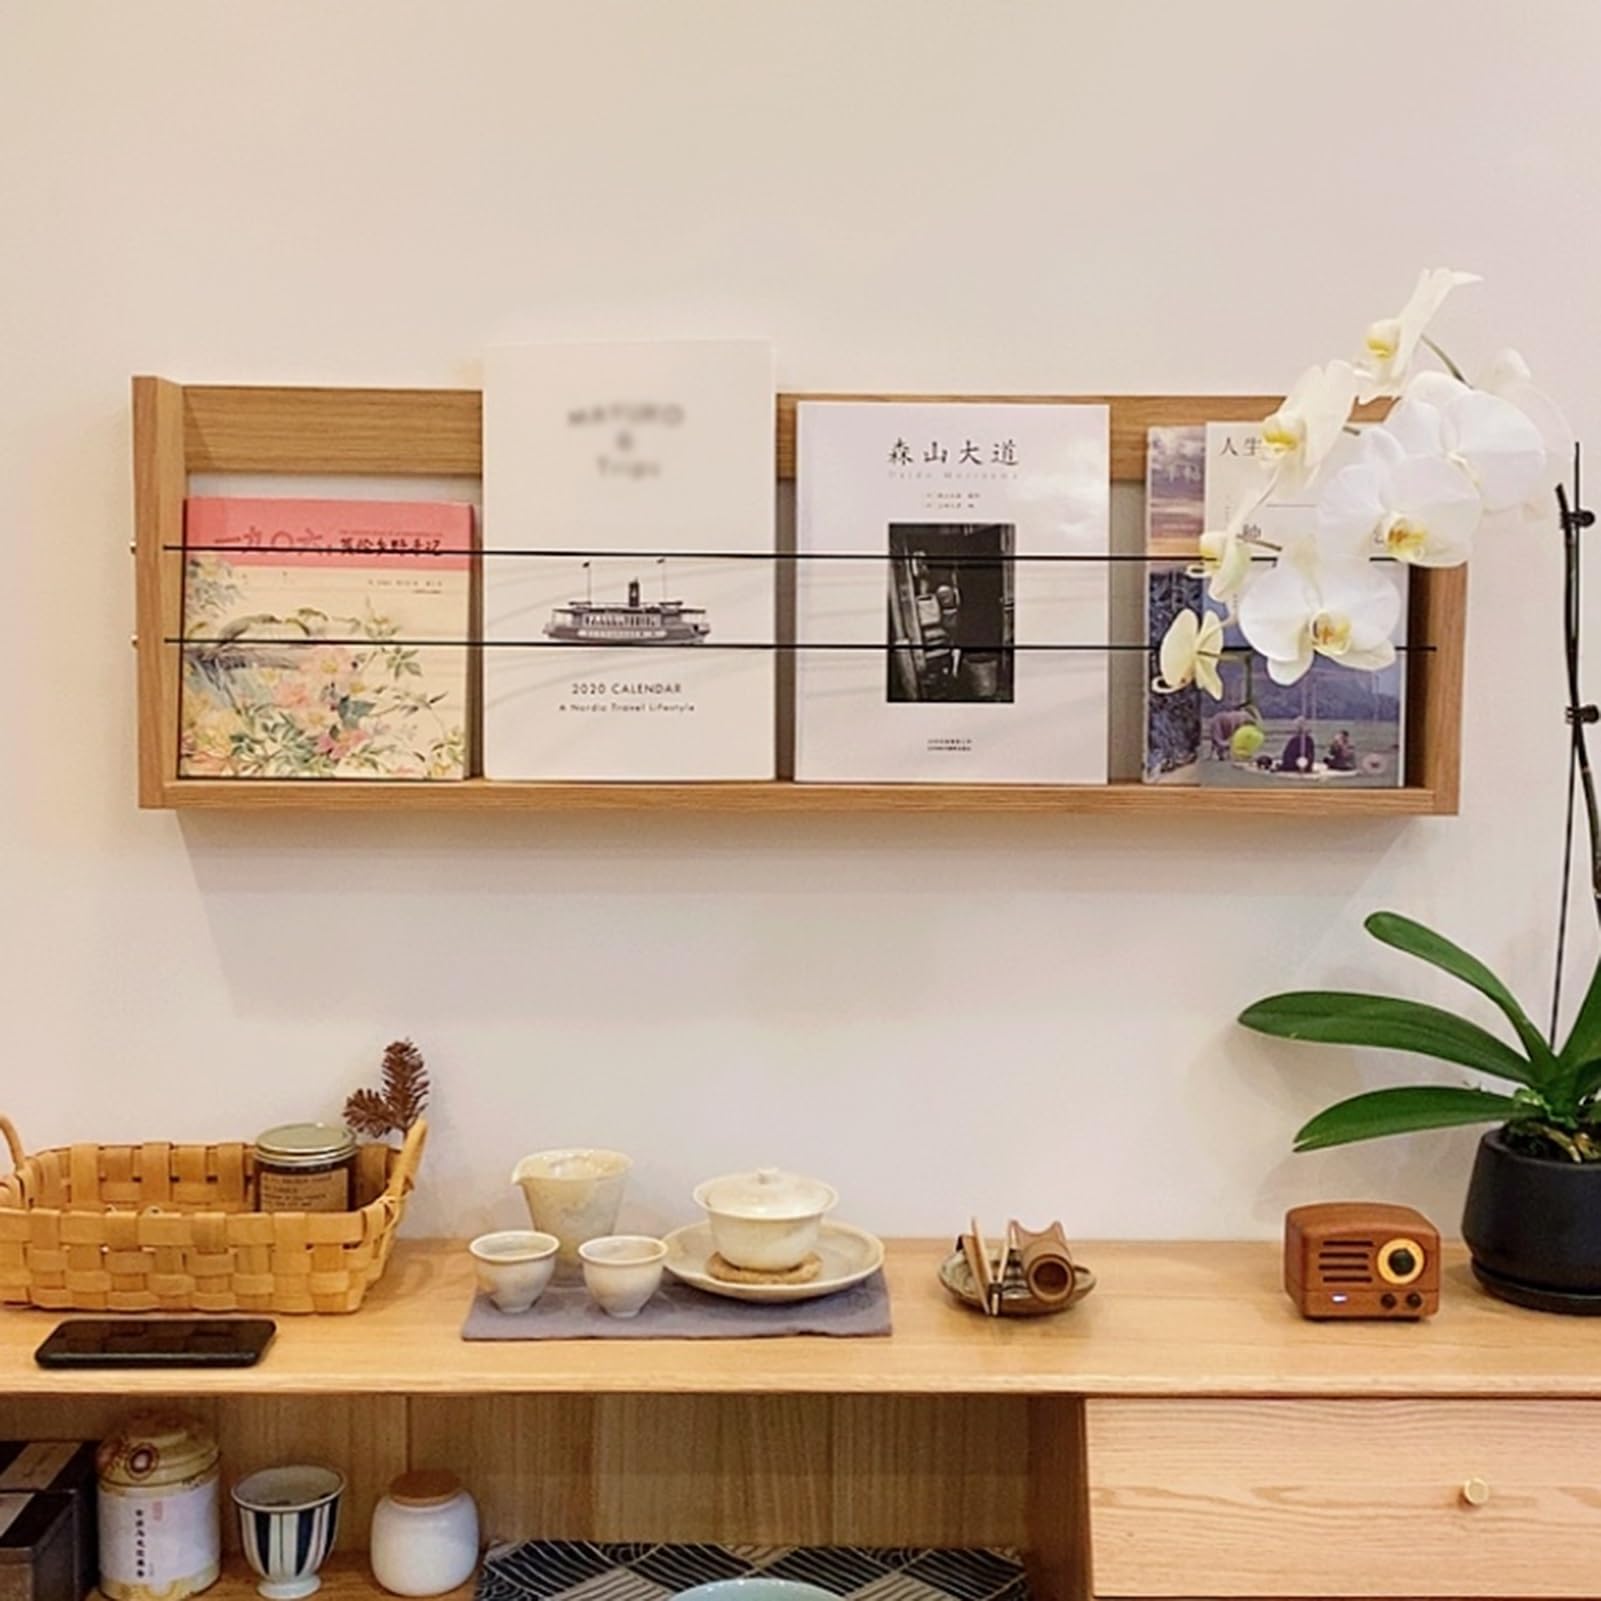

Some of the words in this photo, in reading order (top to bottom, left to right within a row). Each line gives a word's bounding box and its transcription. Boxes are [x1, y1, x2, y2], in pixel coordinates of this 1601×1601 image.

[888, 437, 1020, 466] 森山大道
[571, 682, 607, 695] 2020
[611, 682, 682, 695] CALENDAR
[611, 703, 646, 712] Travel
